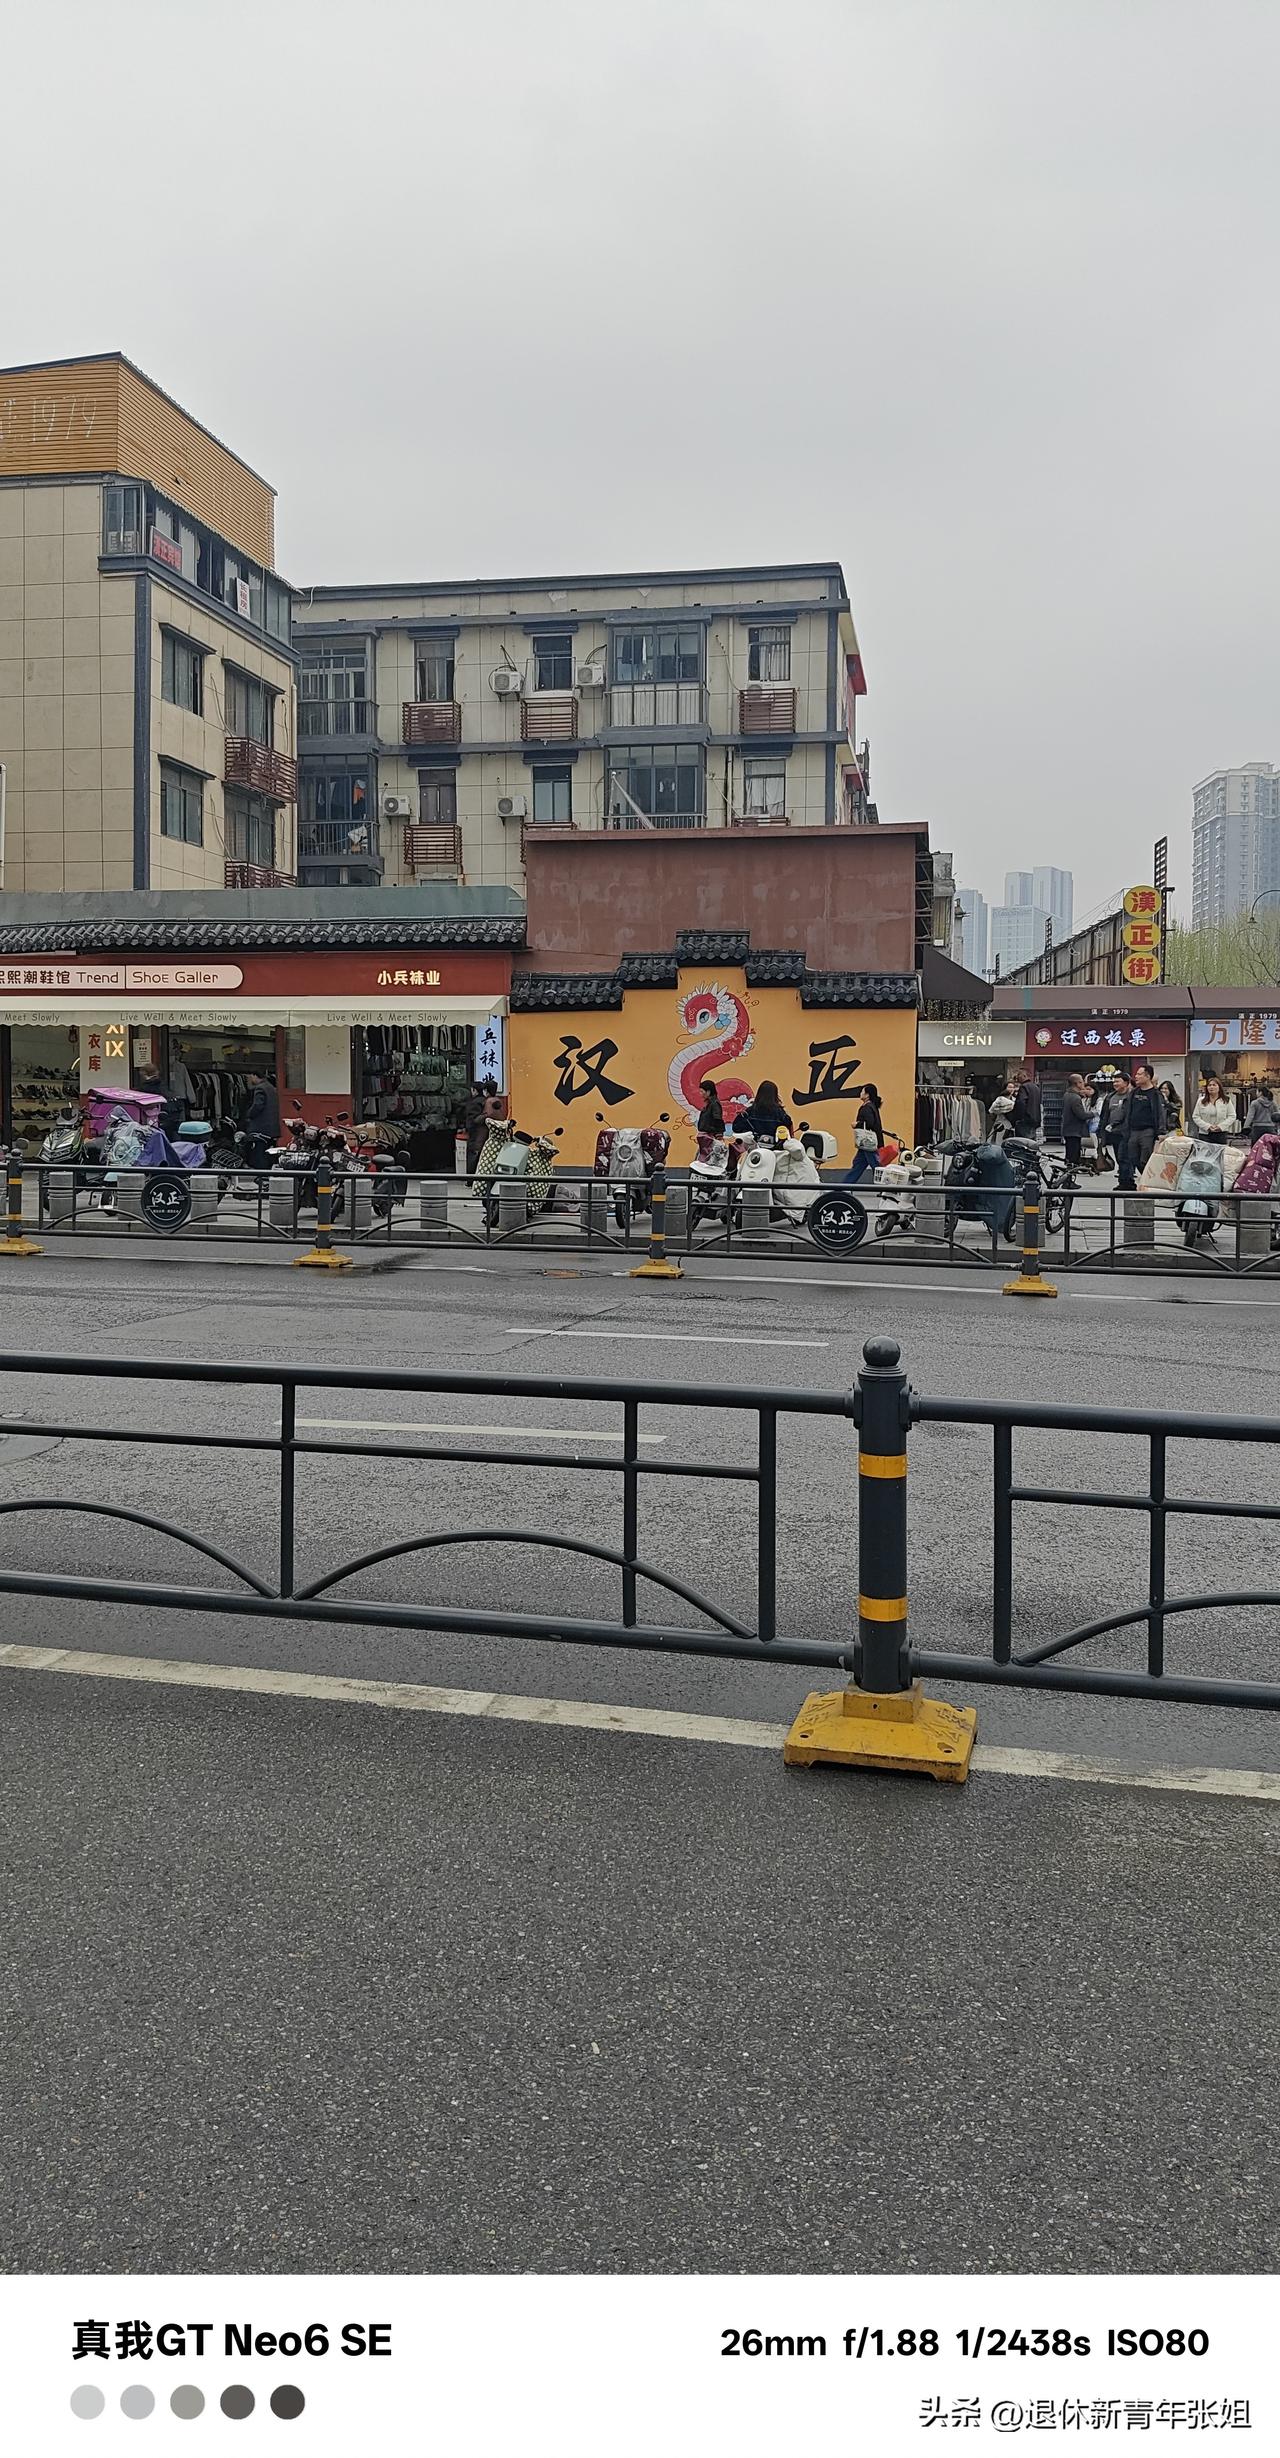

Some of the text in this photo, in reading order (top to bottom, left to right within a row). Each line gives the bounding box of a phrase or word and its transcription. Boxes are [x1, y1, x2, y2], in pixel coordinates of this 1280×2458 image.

[1128, 891, 1156, 981] 漢正街
[76, 971, 119, 983] Trend
[175, 971, 218, 983] Galler
[377, 970, 441, 986] 小兵袜业
[4, 1013, 60, 1022] Meet Slowly
[120, 1013, 138, 1021] Live
[143, 1012, 164, 1021] Well
[180, 1013, 202, 1021] Meet
[207, 1012, 237, 1022] Slowly
[327, 1013, 346, 1021] Live
[351, 1013, 372, 1021] Well
[388, 1013, 412, 1021] Meet
[417, 1012, 447, 1022] Slowly
[943, 1033, 992, 1046] CHÉNI
[151, 1191, 180, 1206] 汉正
[821, 1209, 854, 1226] 汉正
